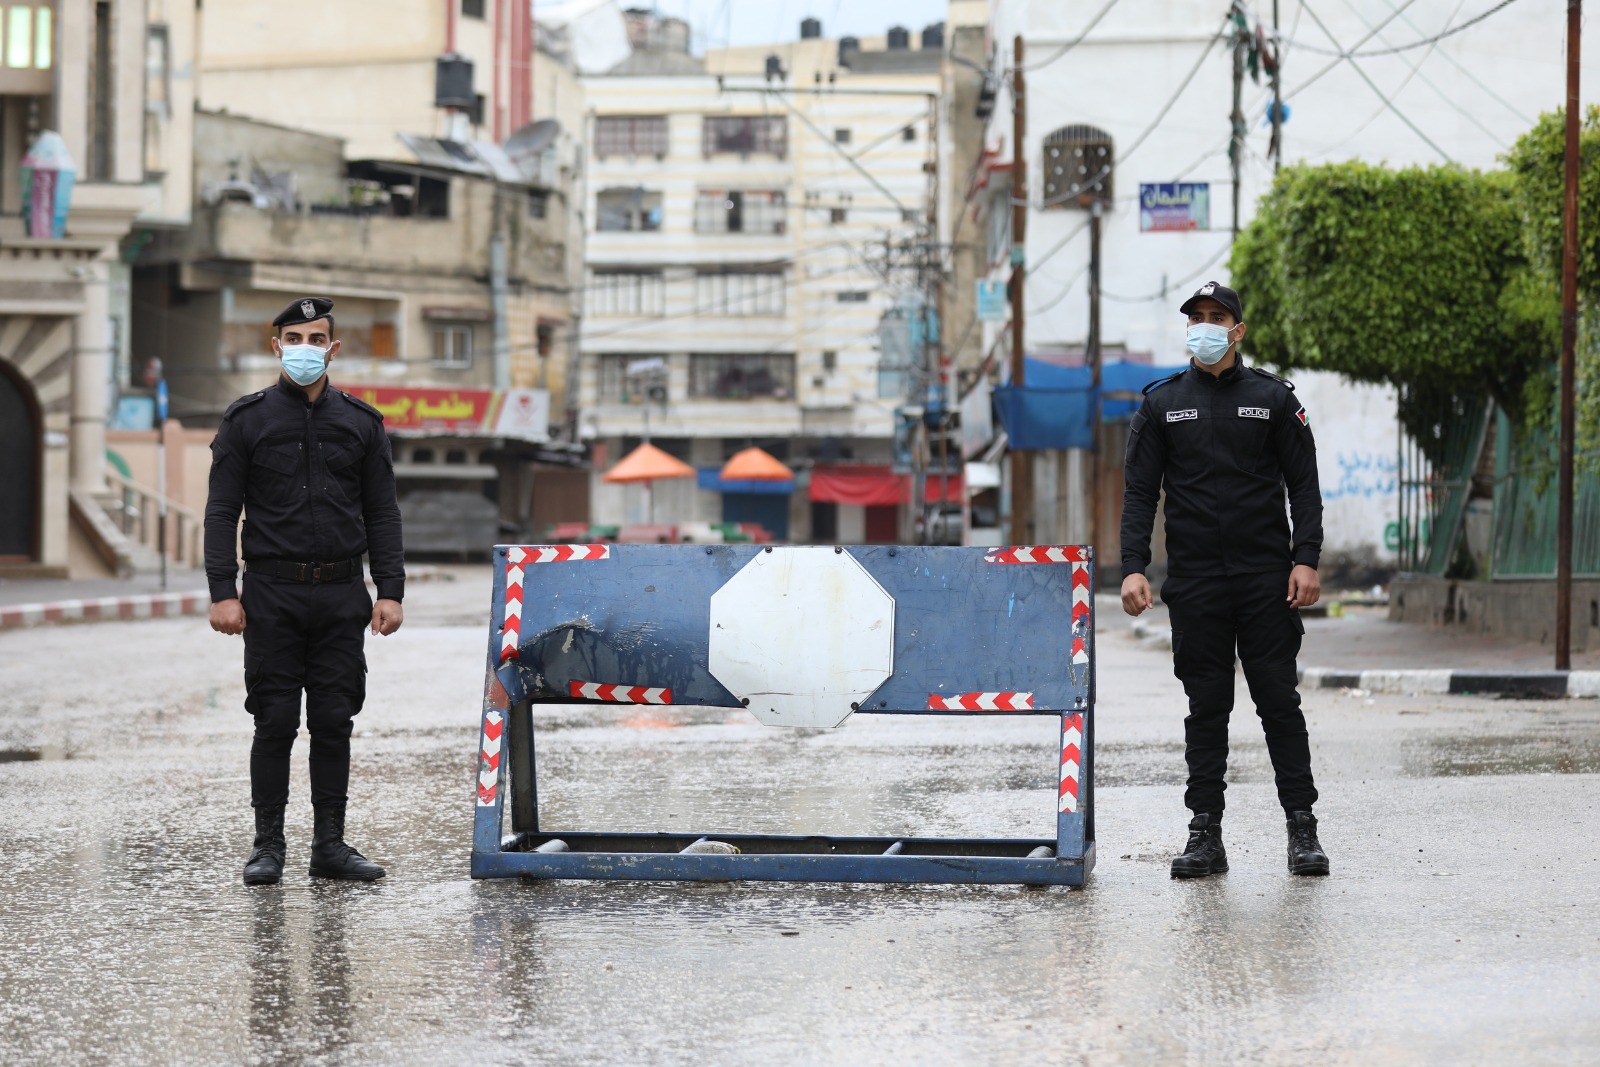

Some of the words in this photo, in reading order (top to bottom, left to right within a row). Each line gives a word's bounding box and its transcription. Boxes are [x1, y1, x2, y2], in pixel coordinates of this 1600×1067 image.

[1144, 183, 1193, 208] سليمان
[415, 393, 475, 423] مطعم
[1240, 408, 1268, 417] POLICE
